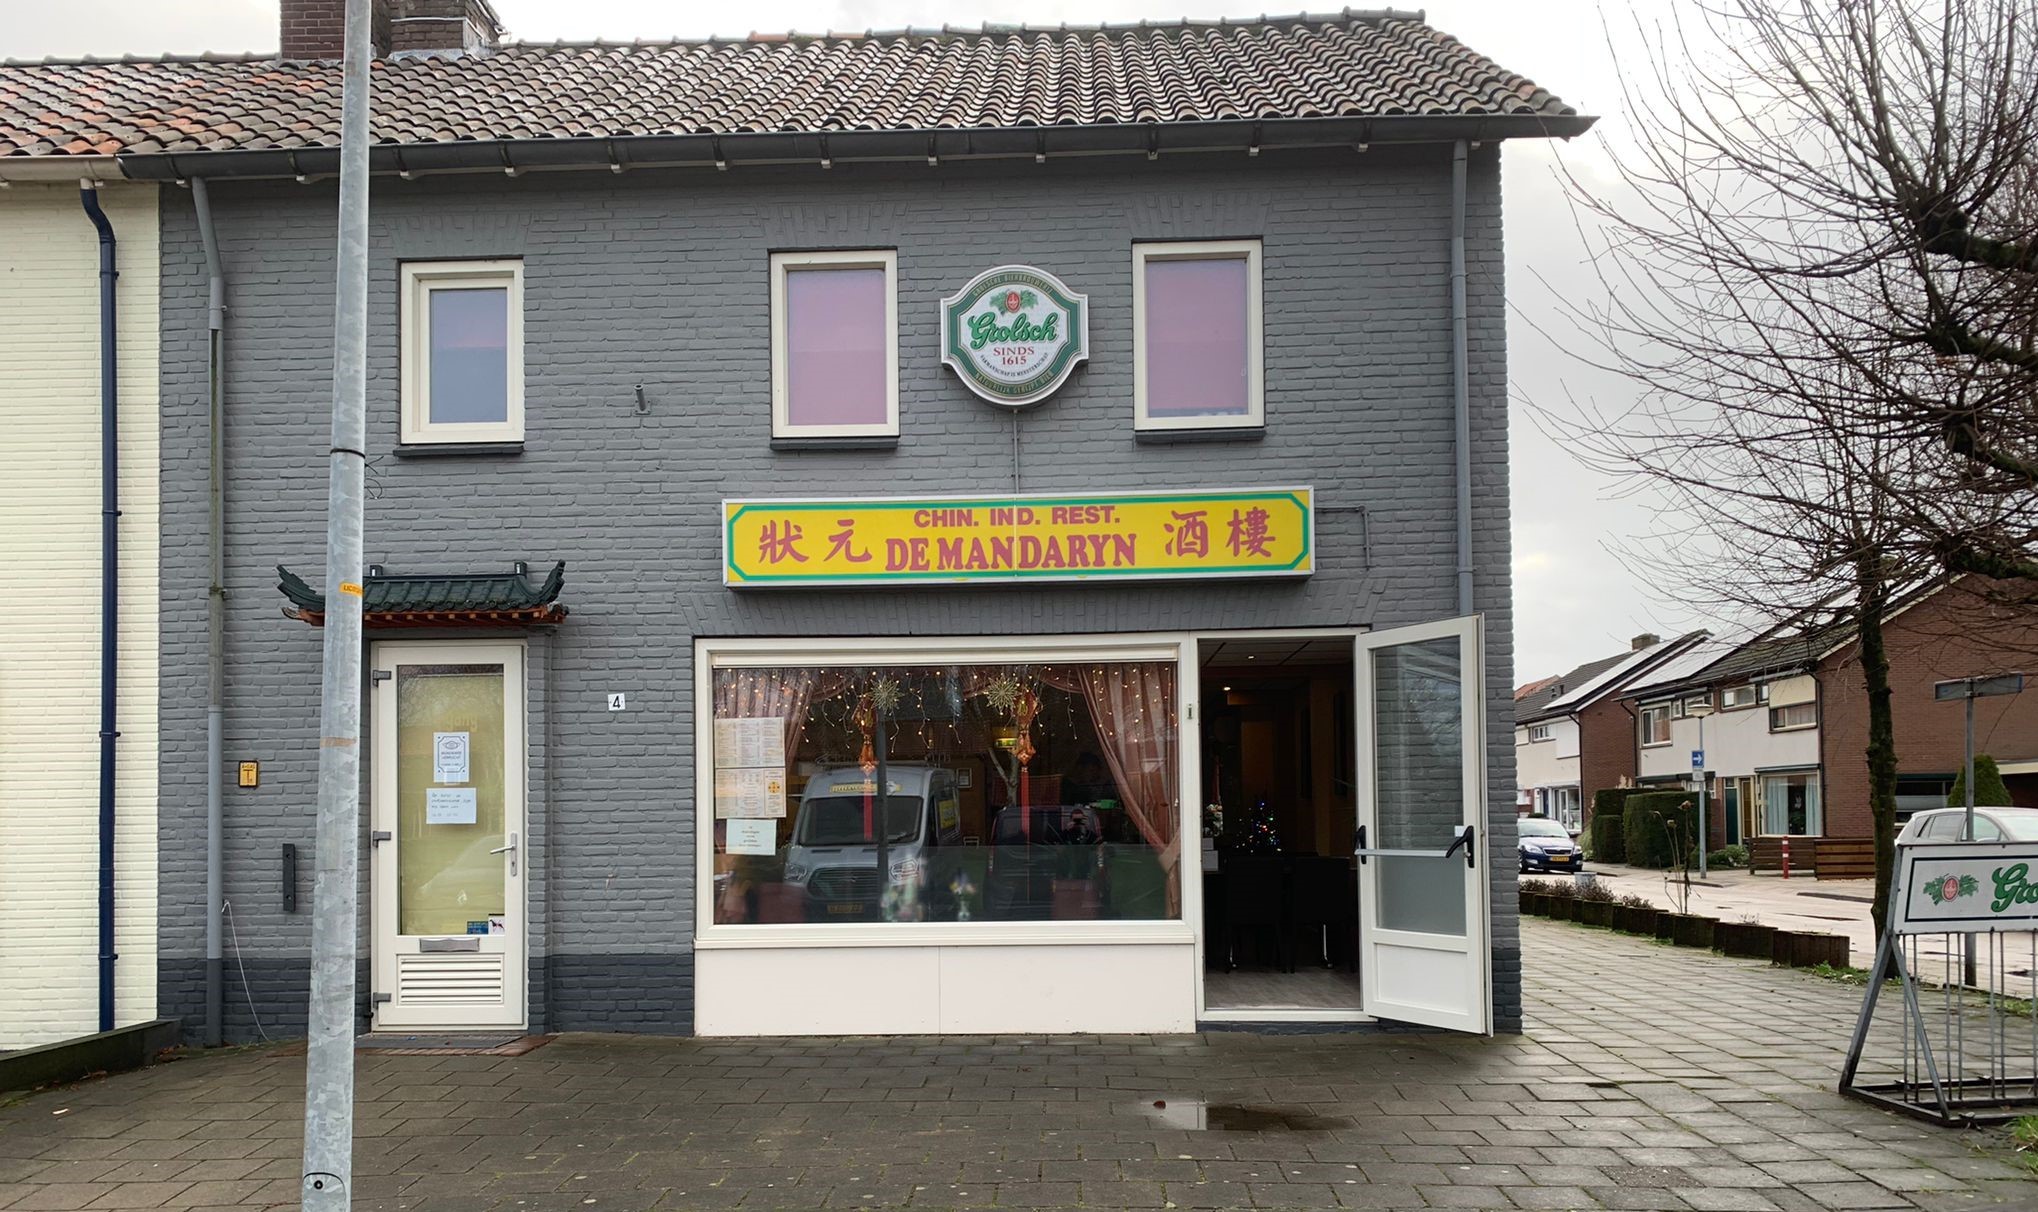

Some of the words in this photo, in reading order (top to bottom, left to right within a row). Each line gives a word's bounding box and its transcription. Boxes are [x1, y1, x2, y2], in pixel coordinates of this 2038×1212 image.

[967, 311, 1059, 350] Grolsch
[993, 345, 1035, 356] SINDS
[1002, 355, 1027, 366] 1615
[914, 509, 980, 528] CHIN.
[989, 508, 1041, 527] IND.
[1051, 505, 1121, 525] REST.
[758, 519, 873, 565] 狀元
[1163, 508, 1277, 559] 酒樓
[885, 537, 931, 571] DE
[936, 532, 1137, 570] MANDARYN
[612, 695, 621, 709] 4
